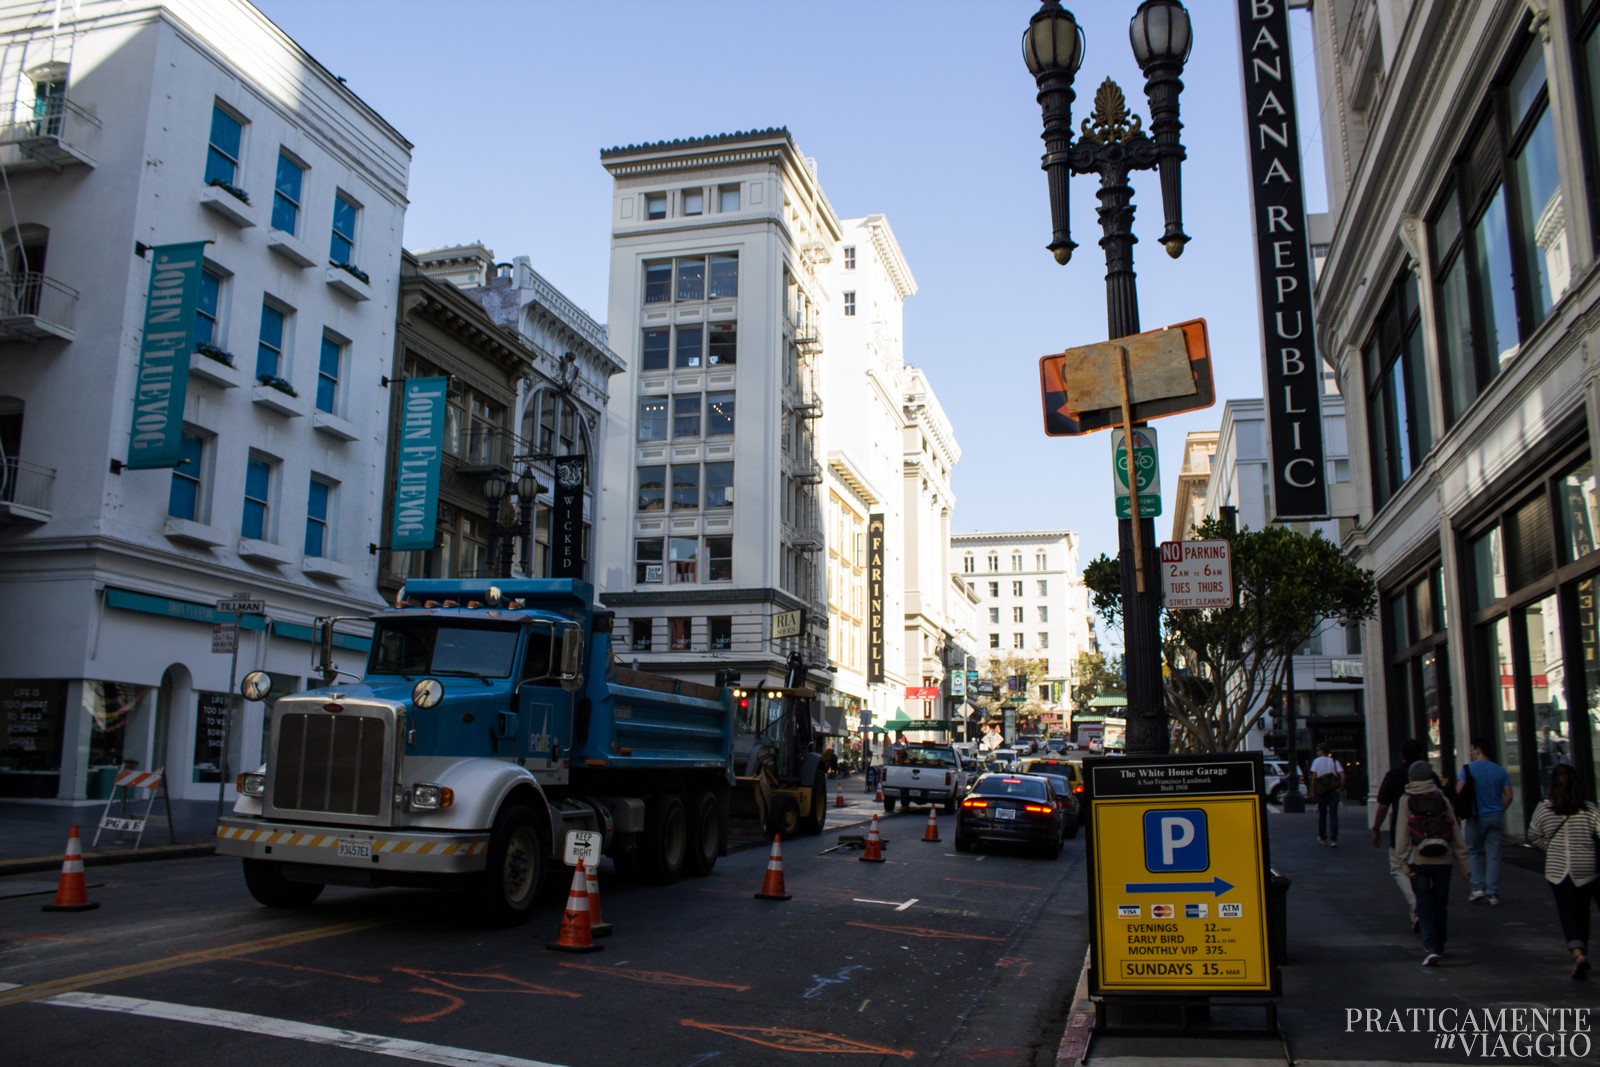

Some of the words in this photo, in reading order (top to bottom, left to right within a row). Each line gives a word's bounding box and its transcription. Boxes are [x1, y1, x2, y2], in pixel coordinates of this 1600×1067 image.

[1250, 0, 1293, 187] BANANA
[148, 254, 196, 324] JOHN
[1266, 205, 1317, 488] REPUBLIC
[133, 330, 187, 449] FLUEVOG
[404, 385, 442, 439] JOHN
[396, 445, 437, 536] FLUEVOG
[562, 496, 574, 568] WICKED
[1162, 543, 1181, 561] NO
[1185, 546, 1226, 560] PARKING
[1170, 582, 1191, 593] TUES
[1197, 581, 1224, 593] THURS
[220, 602, 260, 611] TILLMAN
[871, 537, 882, 676] FARINELLI
[1168, 598, 1193, 606] STREET
[1195, 597, 1227, 606] CLEANING
[777, 613, 796, 628] RIA
[776, 627, 796, 636] SHOES
[211, 696, 224, 704] LIFE
[203, 706, 217, 715] TOO
[207, 717, 215, 726] TO
[1119, 769, 1136, 778] The
[1138, 768, 1165, 778] White
[1168, 768, 1194, 777] House
[1197, 767, 1228, 776] Garage
[575, 832, 592, 841] KEEP
[1161, 817, 1195, 865] P
[573, 848, 592, 857] RIGHT
[1222, 904, 1239, 912] ATM
[1127, 923, 1178, 933] EVENINGS
[1127, 935, 1158, 944] EARLY
[1160, 935, 1185, 943] BIRD
[1128, 946, 1178, 955] MONTHLY
[1181, 946, 1198, 955] VIP
[1205, 945, 1227, 955] 375.
[1126, 963, 1193, 976] SUNDAYS
[1202, 963, 1224, 975] 15.
